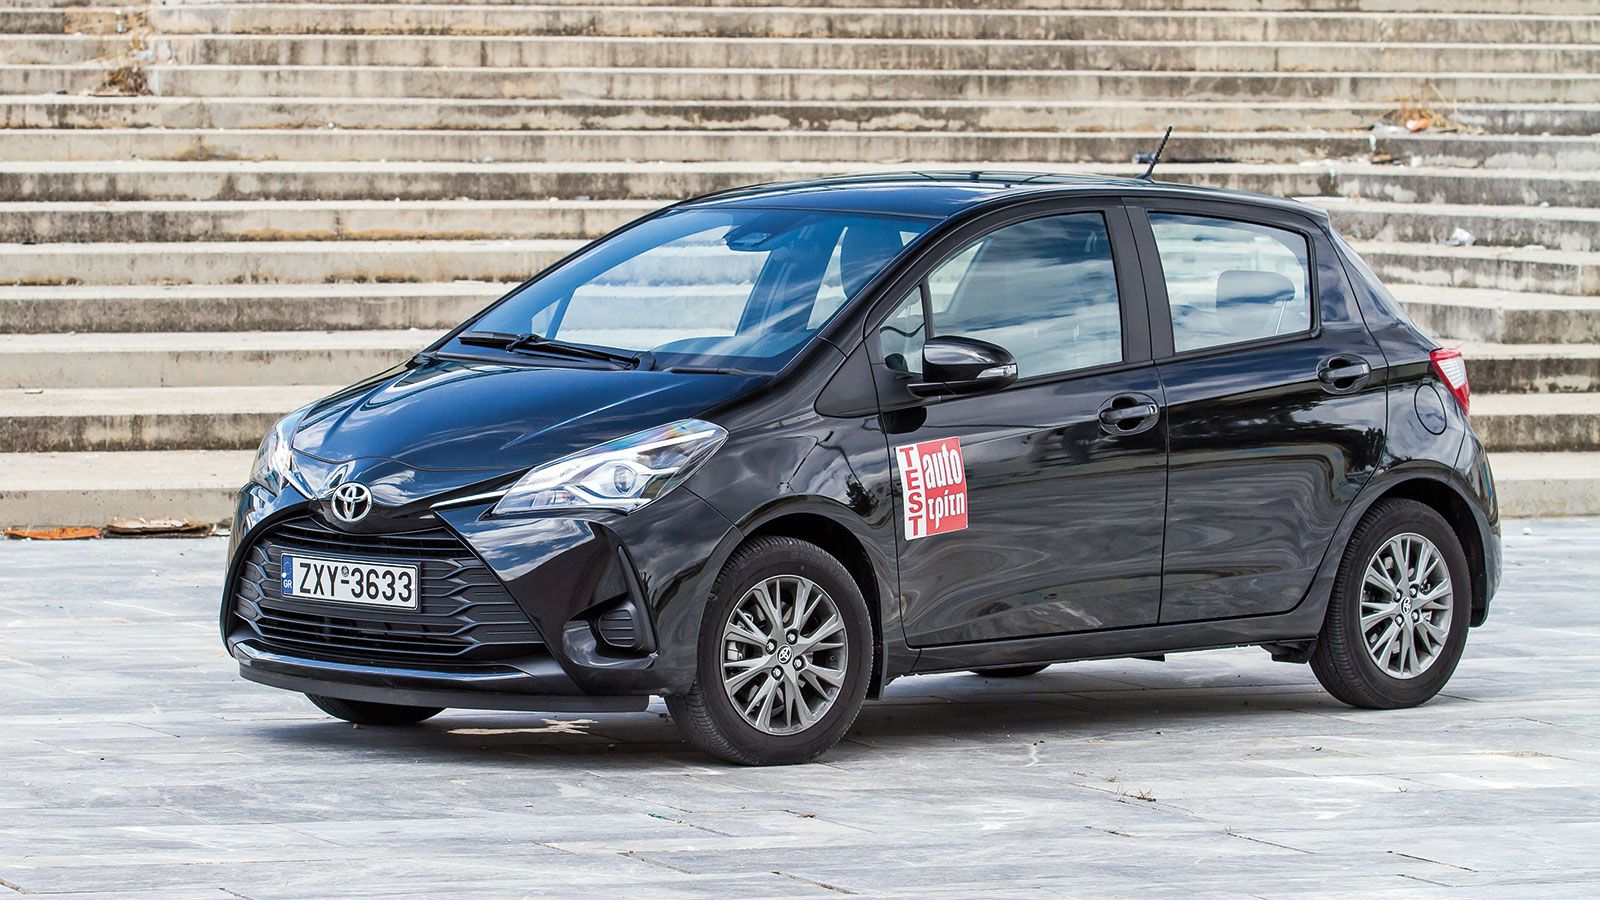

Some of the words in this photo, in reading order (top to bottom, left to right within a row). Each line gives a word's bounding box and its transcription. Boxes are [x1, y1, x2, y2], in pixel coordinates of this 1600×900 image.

[922, 443, 963, 490] auto
[899, 446, 923, 537] TEST
[283, 579, 293, 589] GR
[299, 562, 413, 603] ZXY-3633
